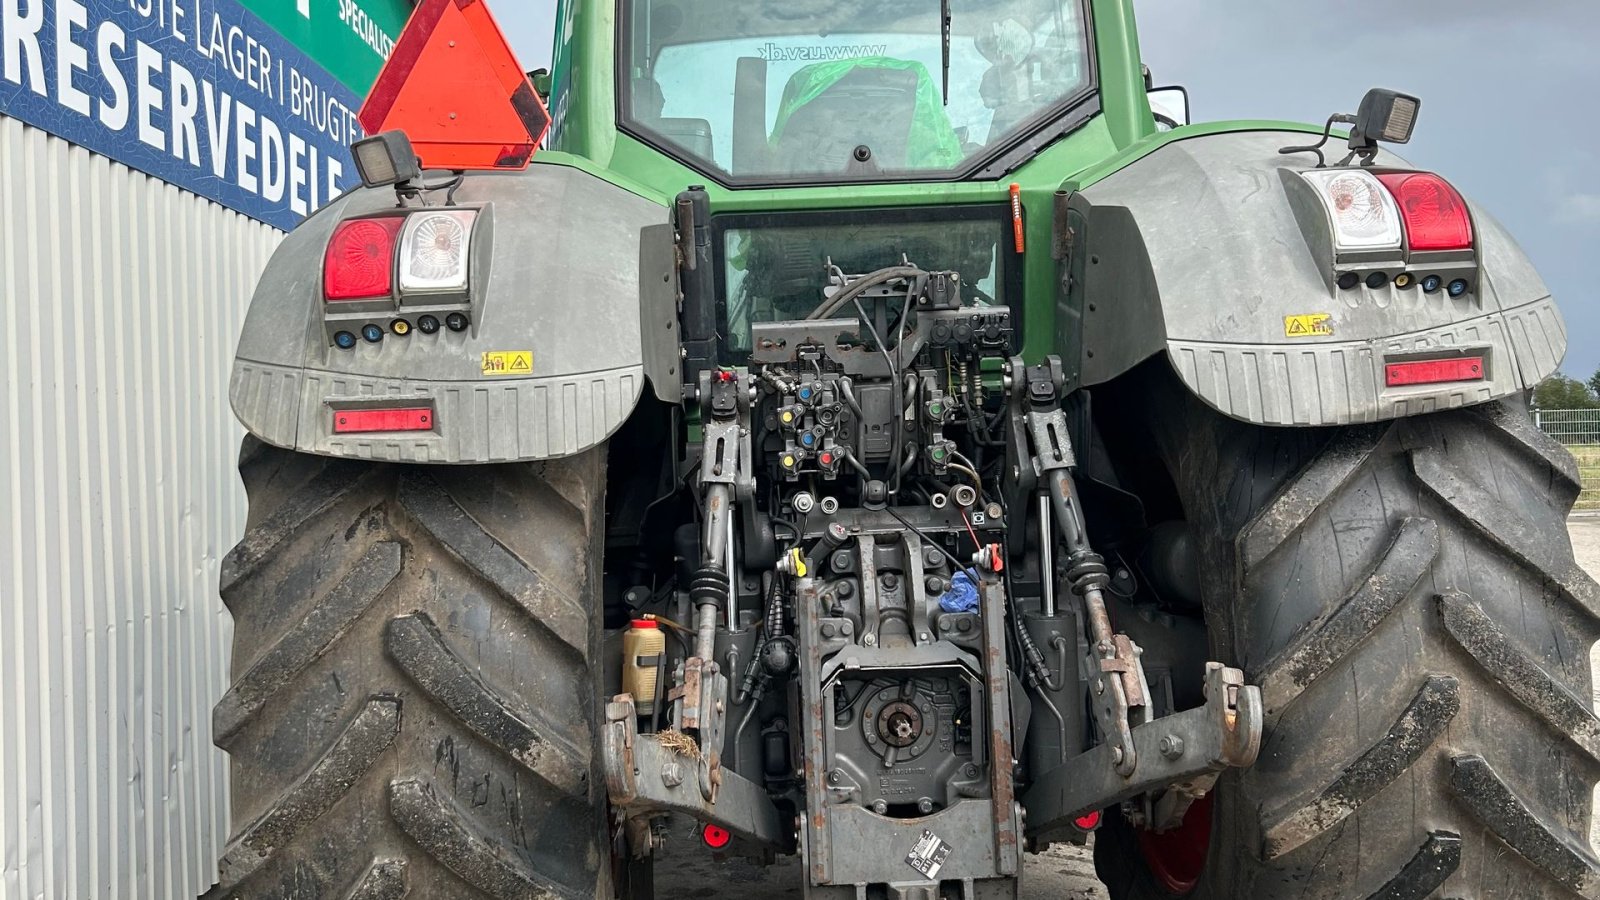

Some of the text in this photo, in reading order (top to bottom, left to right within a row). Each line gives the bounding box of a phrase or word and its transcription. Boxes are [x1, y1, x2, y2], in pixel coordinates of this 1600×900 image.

[196, 0, 273, 99] LAGER
[279, 59, 284, 106] I
[291, 68, 358, 146] BRUGTE
[339, 0, 396, 61] SPECIALIST
[3, 0, 342, 216] RESERVEDELE
